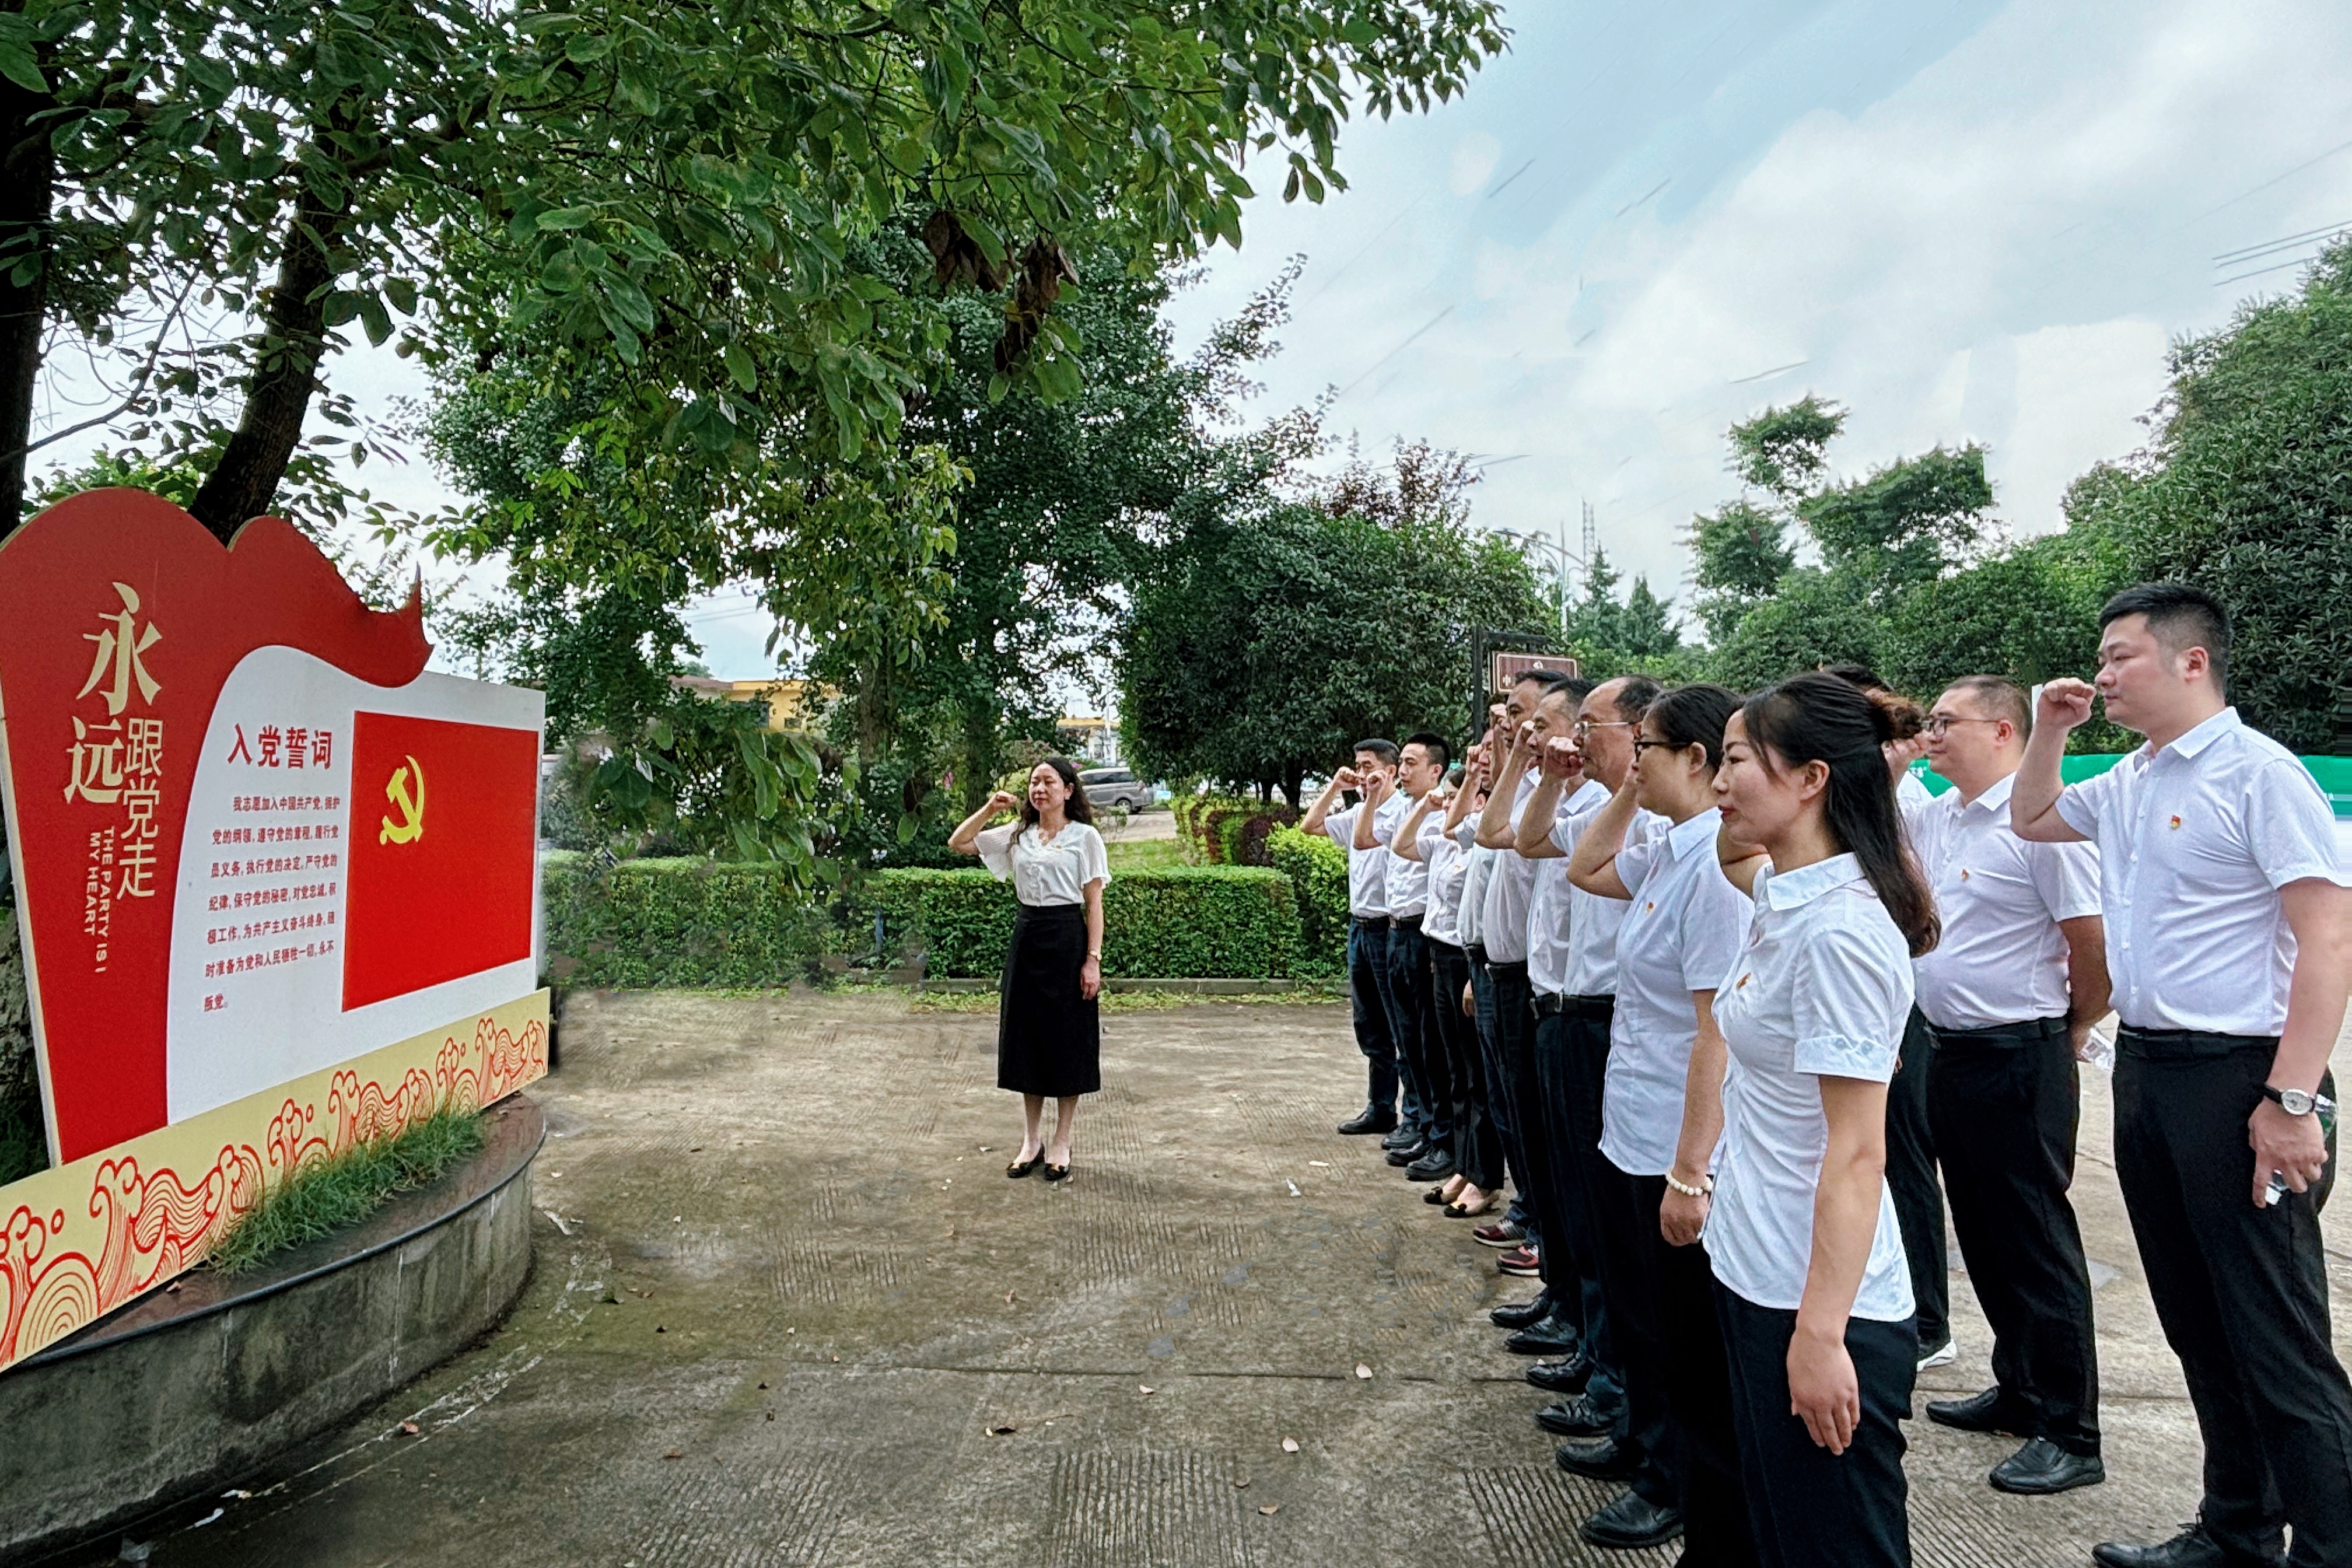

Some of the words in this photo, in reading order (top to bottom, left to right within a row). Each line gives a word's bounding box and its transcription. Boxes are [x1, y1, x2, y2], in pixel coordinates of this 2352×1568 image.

[64, 582, 163, 805] 永远
[228, 723, 332, 770] 入党誓词
[117, 718, 163, 900] 跟党走
[89, 832, 101, 861] MY
[102, 825, 115, 865] THE
[84, 866, 99, 936] HEART
[97, 871, 112, 937] PARTY
[96, 943, 107, 962] IS
